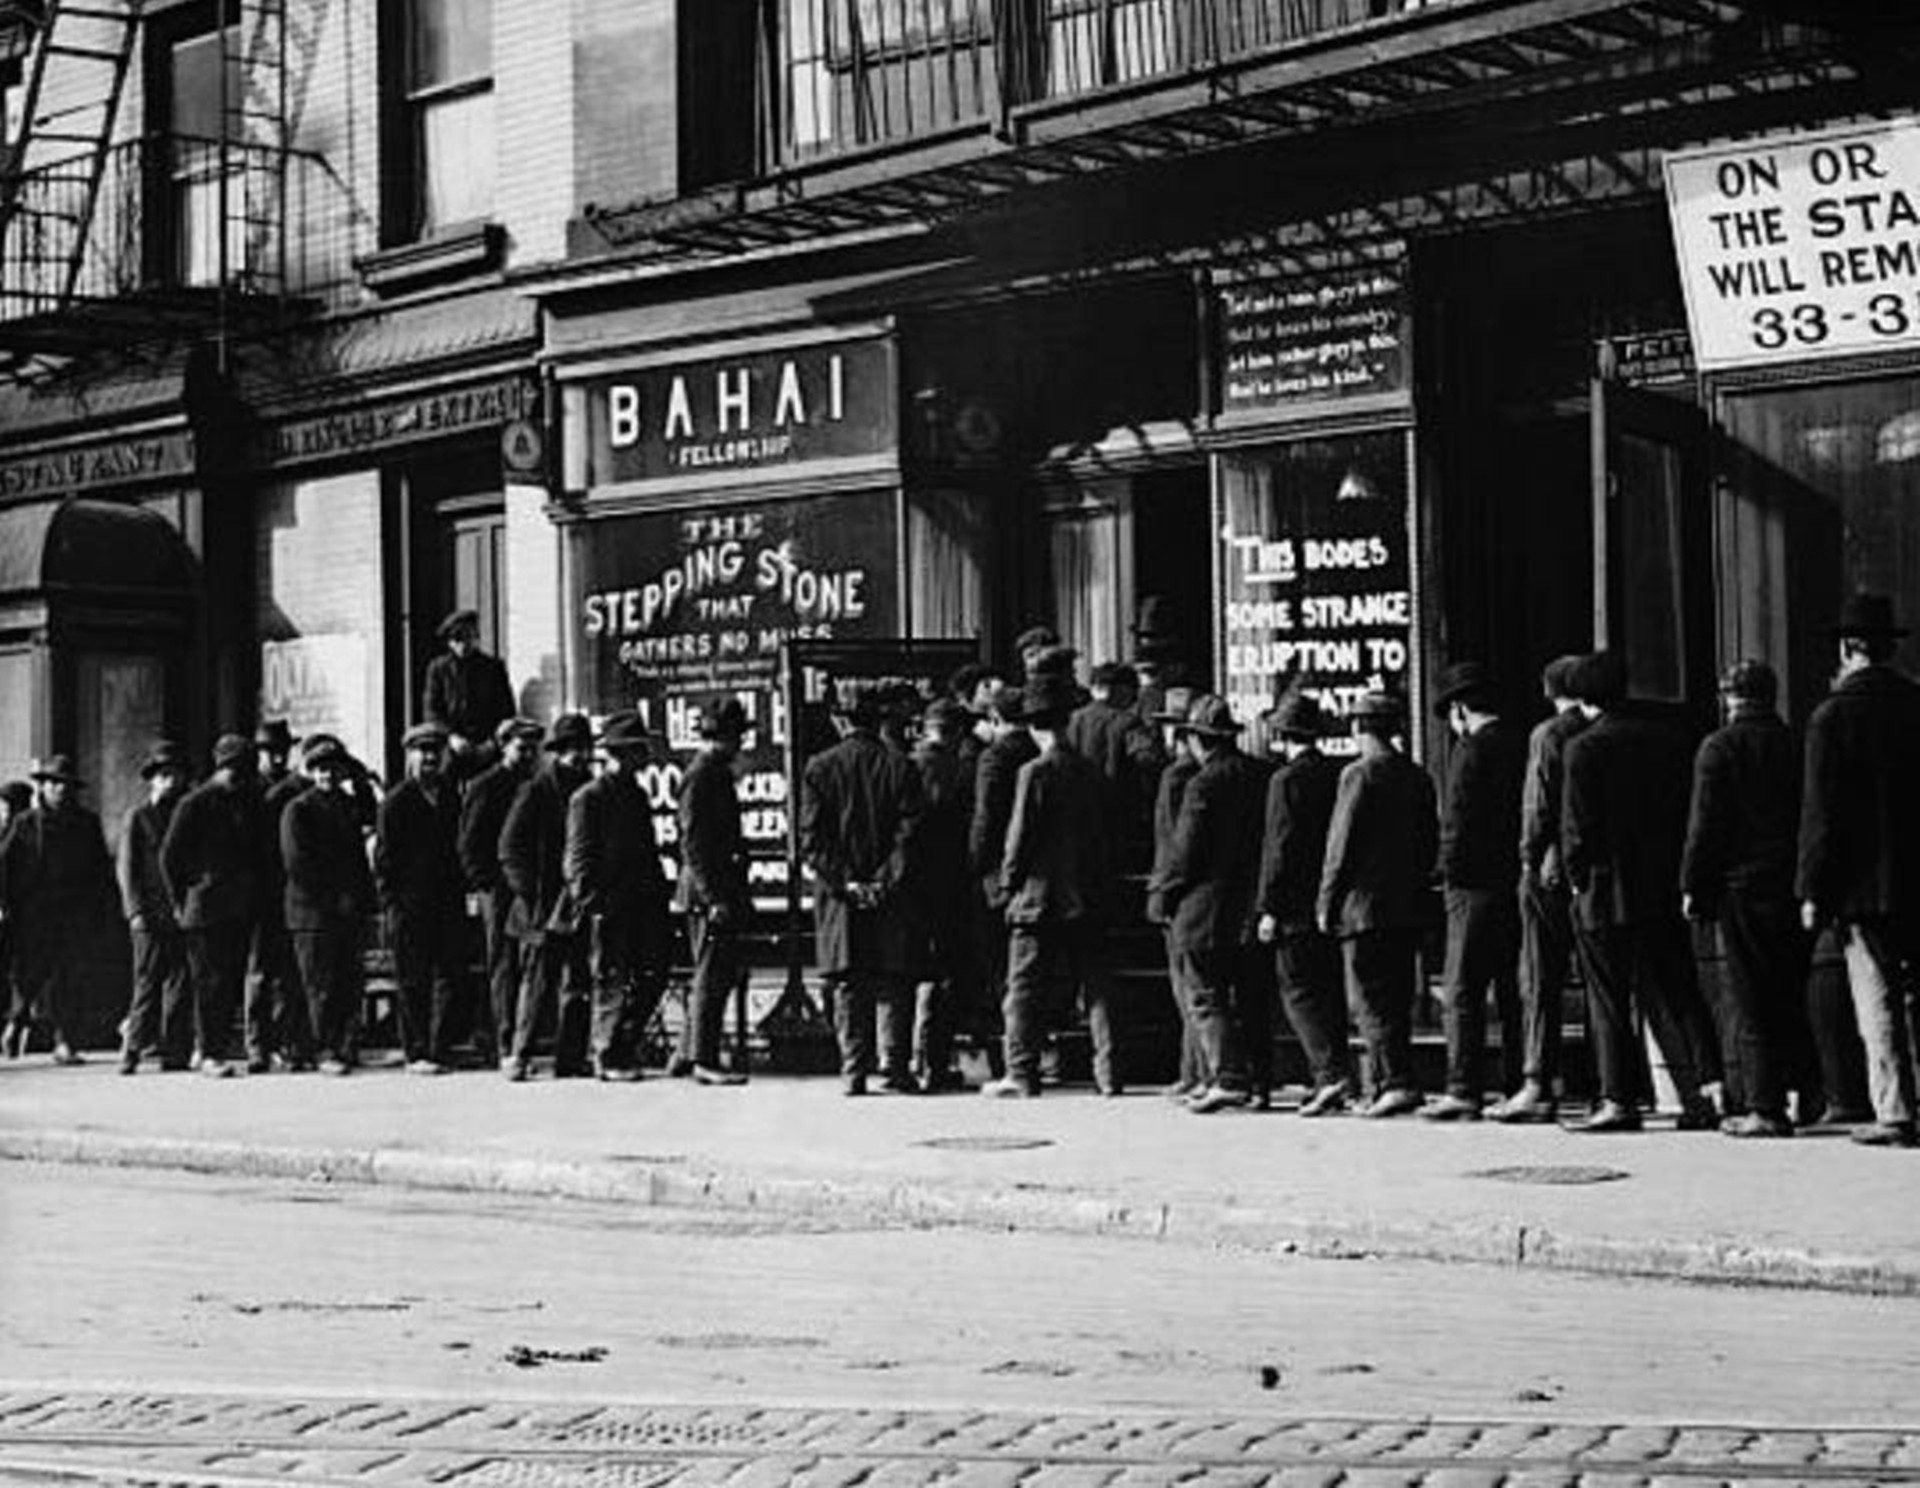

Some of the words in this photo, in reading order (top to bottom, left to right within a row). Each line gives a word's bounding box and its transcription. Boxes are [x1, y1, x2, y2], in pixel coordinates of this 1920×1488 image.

[1717, 156, 1779, 199] ON
[1809, 142, 1888, 185] OR
[1708, 207, 1788, 250] THE
[1707, 256, 1806, 298] WILL
[1819, 240, 1920, 288] REM
[608, 354, 843, 448] BAHAI
[683, 514, 764, 543] THE
[1303, 535, 1389, 570] BODES
[585, 541, 745, 638] STEPPING
[757, 539, 864, 620] STONE
[698, 595, 755, 620] THAT
[1226, 601, 1294, 630] SOME
[1301, 591, 1410, 628] STRANGE
[619, 633, 712, 665] GATHERS
[719, 630, 749, 656] NO
[1227, 640, 1361, 676] ERUPTION
[1365, 638, 1406, 672] TO
